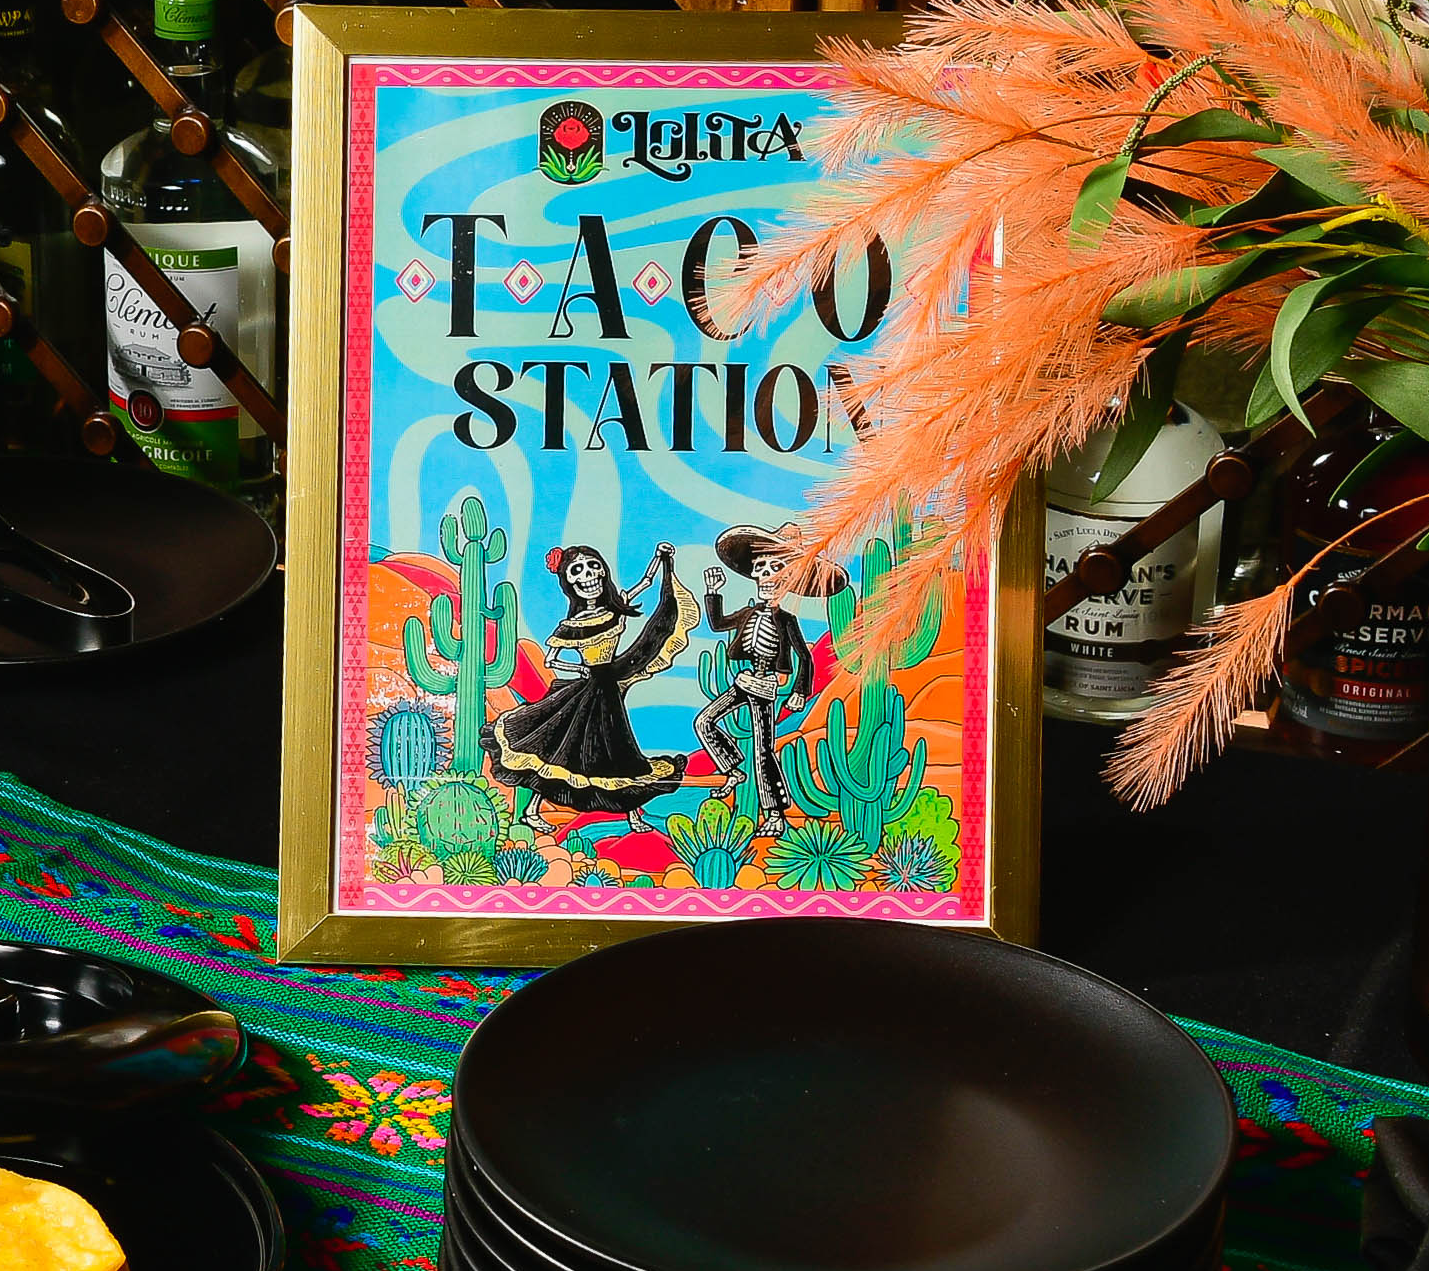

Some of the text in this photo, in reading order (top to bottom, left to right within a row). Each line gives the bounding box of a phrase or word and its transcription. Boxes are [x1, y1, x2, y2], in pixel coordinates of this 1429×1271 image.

[420, 214, 893, 343] TACO
[107, 272, 218, 330] Clémt
[129, 328, 160, 341] RUM
[452, 360, 886, 455] STATION
[142, 444, 213, 465] GRICOLE
[1053, 528, 1074, 540] SAINT
[1065, 615, 1125, 637] RUM
[1333, 625, 1425, 645] SERV
[1070, 642, 1114, 658] WHITE
[1334, 655, 1406, 678] SPIC
[1342, 683, 1412, 699] ORIGINAL
